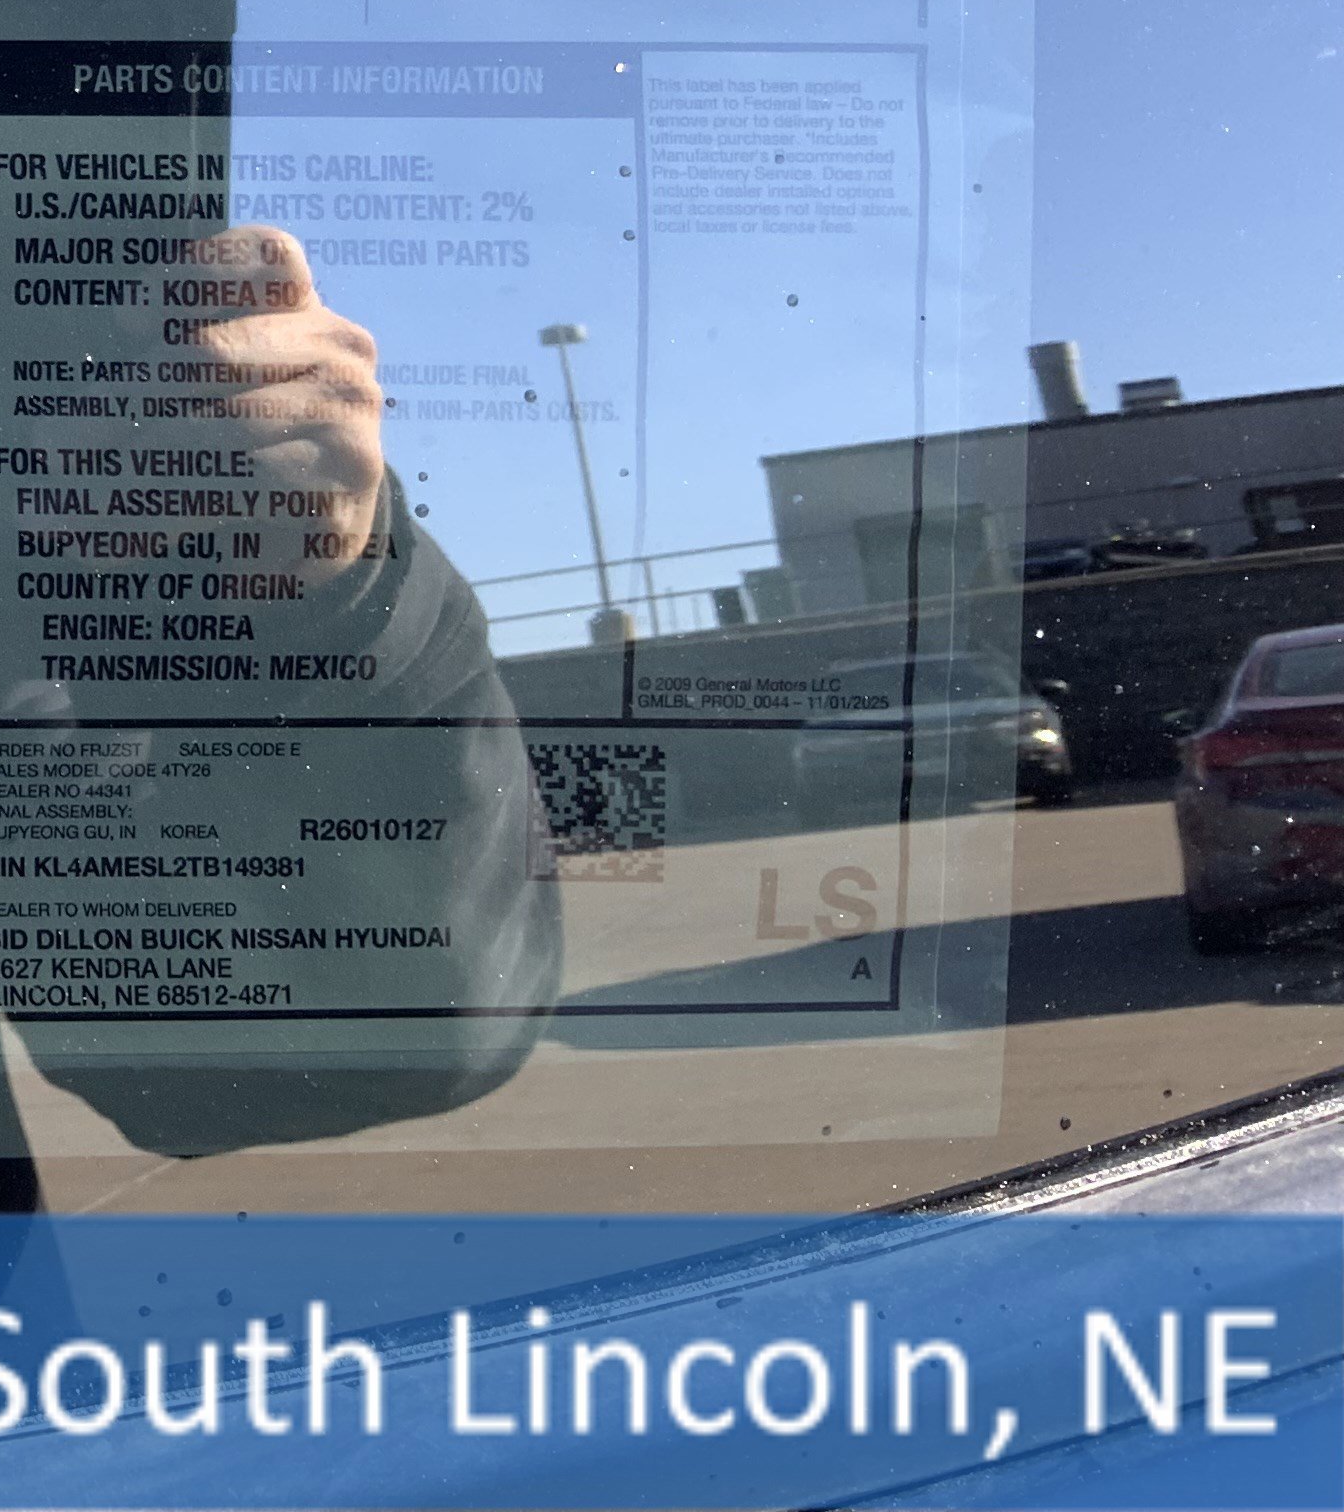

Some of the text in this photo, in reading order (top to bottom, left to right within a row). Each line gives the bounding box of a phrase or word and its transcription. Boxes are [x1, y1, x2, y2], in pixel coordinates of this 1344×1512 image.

[44, 615, 254, 641] ENGINE: KOREA
[41, 655, 376, 681] TRANSMISSION: MEXICO
[301, 819, 446, 841] R26010127
[35, 857, 304, 877] KL4AMESL2TB149381
[756, 868, 885, 945] LS
[37, 929, 132, 949] DILLON
[142, 929, 223, 949] BUICK
[232, 928, 326, 949] NISSAN
[336, 927, 450, 948] HYUNDAI
[52, 958, 159, 978] KENDRA
[167, 957, 231, 978] LANE
[852, 957, 871, 979] A
[116, 985, 149, 1006] NE
[157, 985, 290, 1006] 68512-4871
